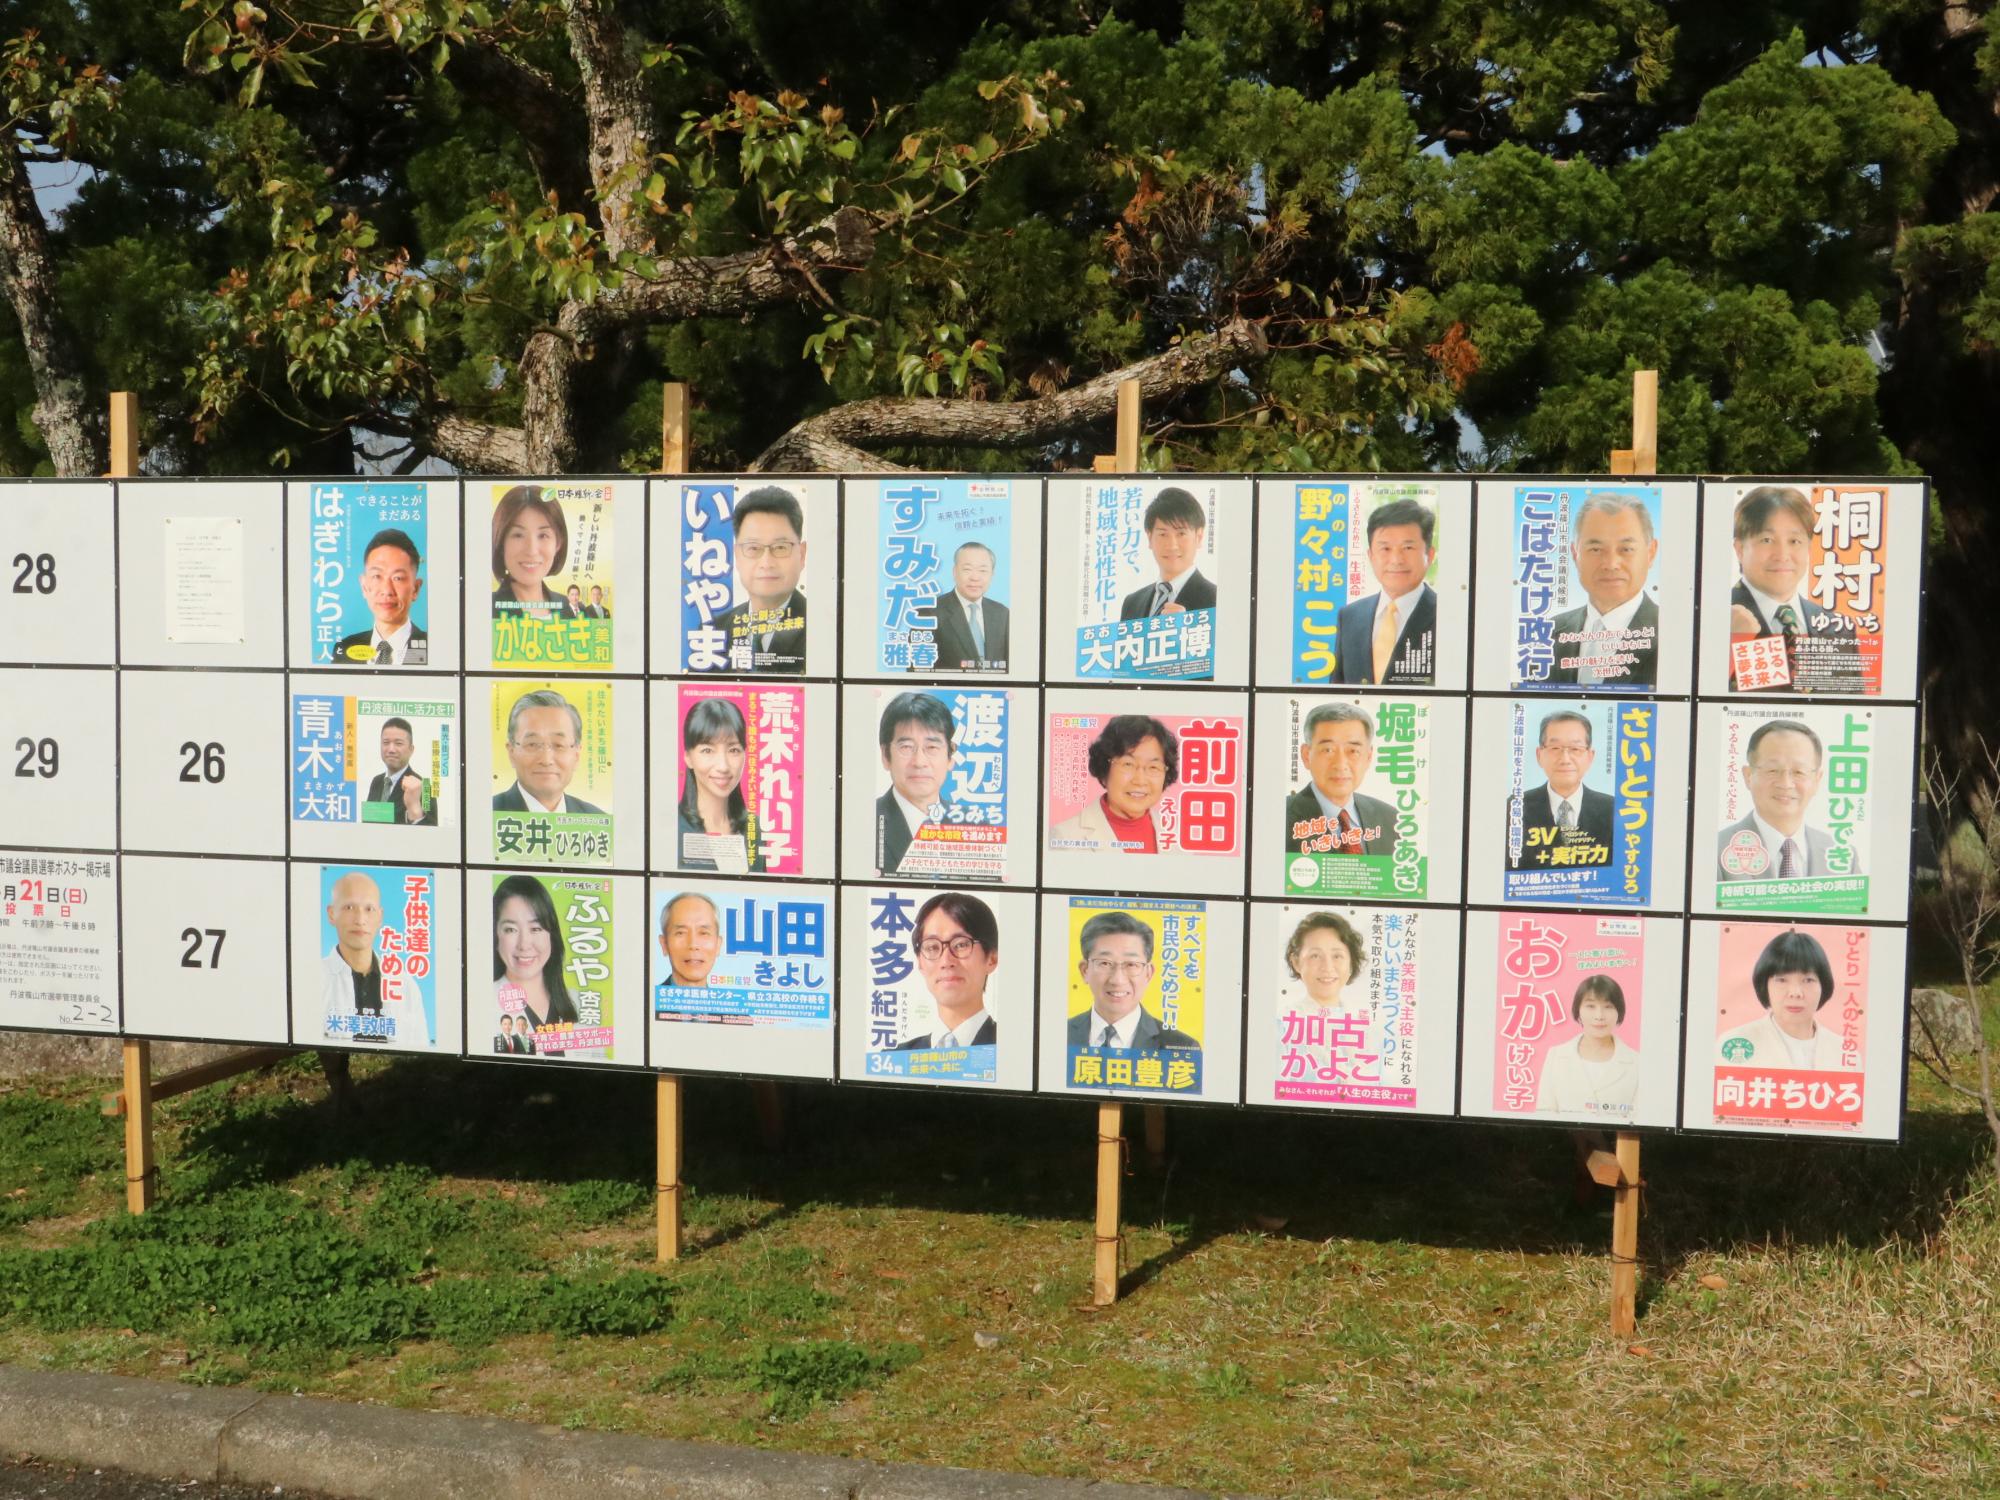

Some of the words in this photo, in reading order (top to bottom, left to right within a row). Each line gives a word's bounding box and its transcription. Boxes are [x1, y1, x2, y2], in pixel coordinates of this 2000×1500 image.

[356, 495, 422, 507] できることが
[379, 510, 421, 521] まだある
[1121, 486, 1143, 574] 若い力で、
[1332, 493, 1345, 586] ののむら
[1811, 489, 1882, 610] 桐村
[12, 553, 57, 594] 28
[313, 487, 345, 623] はぎわら
[884, 486, 940, 629] すみだ
[1095, 486, 1118, 622] 地域活性化！
[684, 489, 732, 670] いねやま
[1298, 488, 1338, 680] 野々村こう
[1518, 492, 1556, 682] こばたけ政行
[316, 625, 335, 662] 正人
[495, 611, 591, 662] かなさき
[594, 627, 609, 661] 美和
[888, 632, 933, 642] まさはる
[1083, 610, 1210, 641] おおうちまさひろ
[1811, 613, 1880, 632] ゆういち
[884, 643, 938, 668] 雅春
[1081, 625, 1211, 673] 大内正博
[1736, 639, 1782, 658] さらに
[1737, 654, 1784, 671] 夢ある
[1739, 669, 1787, 687] 未来へ
[360, 702, 454, 717] 丹波篠山に活力を!!
[1054, 717, 1097, 728] 日本共産党
[14, 737, 59, 779] 29
[297, 699, 334, 778] 青木
[334, 731, 343, 763] あおき
[951, 693, 1004, 804] 渡辺
[1375, 702, 1416, 785] 堀毛
[1416, 707, 1428, 768] ほりけ
[1828, 713, 1870, 794] 上田
[179, 741, 226, 784] 26
[758, 692, 794, 868] 荒木れい子
[993, 756, 1001, 790] わたなべ
[1619, 707, 1652, 830] さいとう
[299, 792, 350, 820] 大和
[304, 782, 345, 791] まさかず
[1179, 720, 1240, 852] 前田
[928, 803, 1004, 825] ひろみち
[1159, 798, 1177, 850] えり子
[1293, 817, 1339, 840] 地域を
[1527, 826, 1557, 847] 3V
[1827, 797, 1854, 872] ひでき
[497, 817, 552, 854] 安井
[556, 831, 609, 858] ひろゆき
[1301, 826, 1381, 855] いきいきと!
[1394, 789, 1420, 892] ひろあき
[0, 858, 111, 878] 市議会議員選挙ポスター掲示場
[1509, 871, 1597, 885] 取り組んでいます！
[1624, 833, 1640, 894] やすひろ
[0, 879, 88, 904] 月21日(日)
[181, 928, 227, 970] 27
[405, 876, 431, 978] 子供達の
[565, 893, 611, 987] ふるや
[726, 898, 825, 958] 山田
[870, 892, 915, 986] 本多
[1184, 915, 1200, 979] すべてを
[380, 927, 403, 1002] ために
[710, 975, 751, 985] 日本共産党
[754, 960, 824, 988] きよし
[1161, 914, 1180, 1030] 市民のために!!
[1370, 914, 1383, 1022] 本気で取り組みます!
[1501, 919, 1567, 1040] おか
[579, 991, 602, 1026] 杏奈
[1383, 914, 1403, 1066] 楽しいまちづくりに
[1400, 914, 1417, 1085] みんなが笑顔で主役になれる
[1842, 931, 1860, 1067] ひとり一人のために
[59, 1015, 73, 1024] No.
[326, 1014, 396, 1036] 米澤敦晴
[871, 990, 898, 1048] 紀元
[1281, 1010, 1369, 1049] 加古
[1073, 1055, 1196, 1090] 原田豊彦
[1281, 1048, 1380, 1082] かよこ
[1504, 1044, 1534, 1109] けい子
[1716, 1076, 1861, 1112] 向井ちひろ
